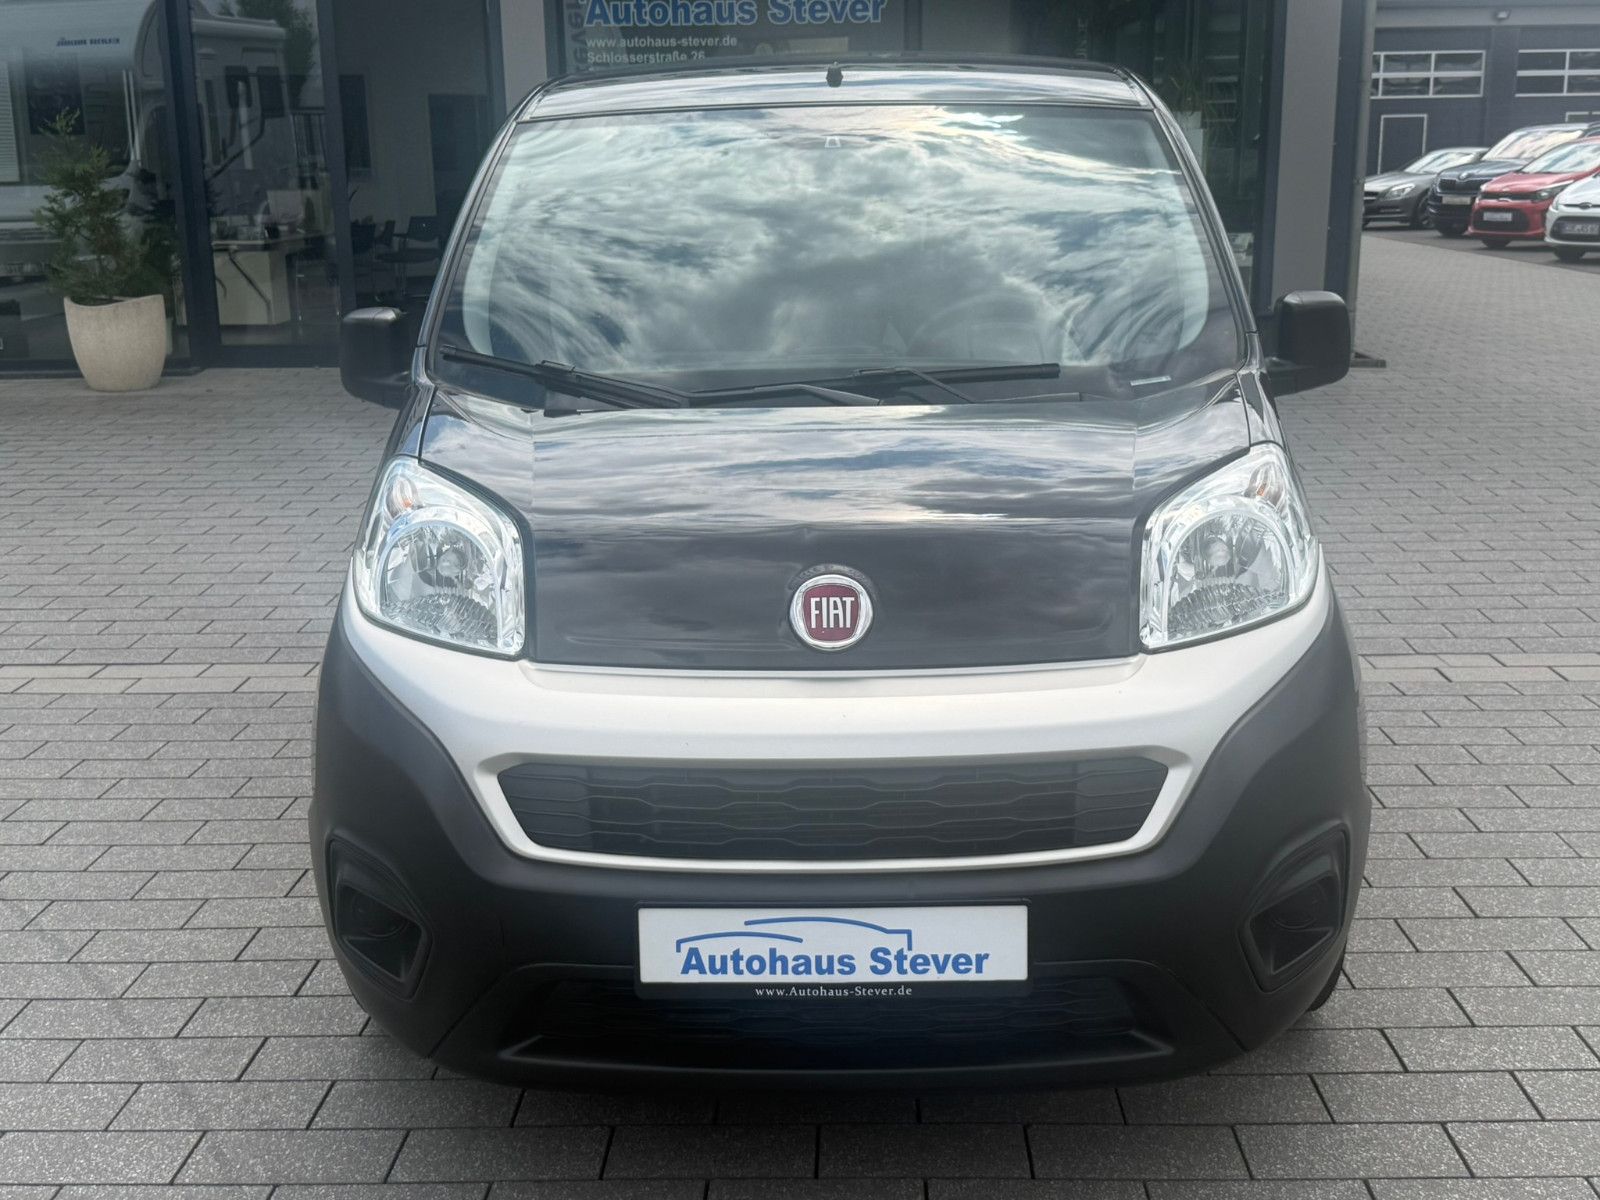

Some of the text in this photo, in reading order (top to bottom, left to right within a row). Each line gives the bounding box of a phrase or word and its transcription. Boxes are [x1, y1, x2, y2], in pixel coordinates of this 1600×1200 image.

[584, 0, 887, 27] Autohaus Stever
[586, 35, 738, 48] www.autohaus-stever.de
[810, 597, 855, 629] FIAT
[680, 946, 990, 976] Autohaus Stever
[755, 985, 913, 997] www.Autohaus-Stever.de
